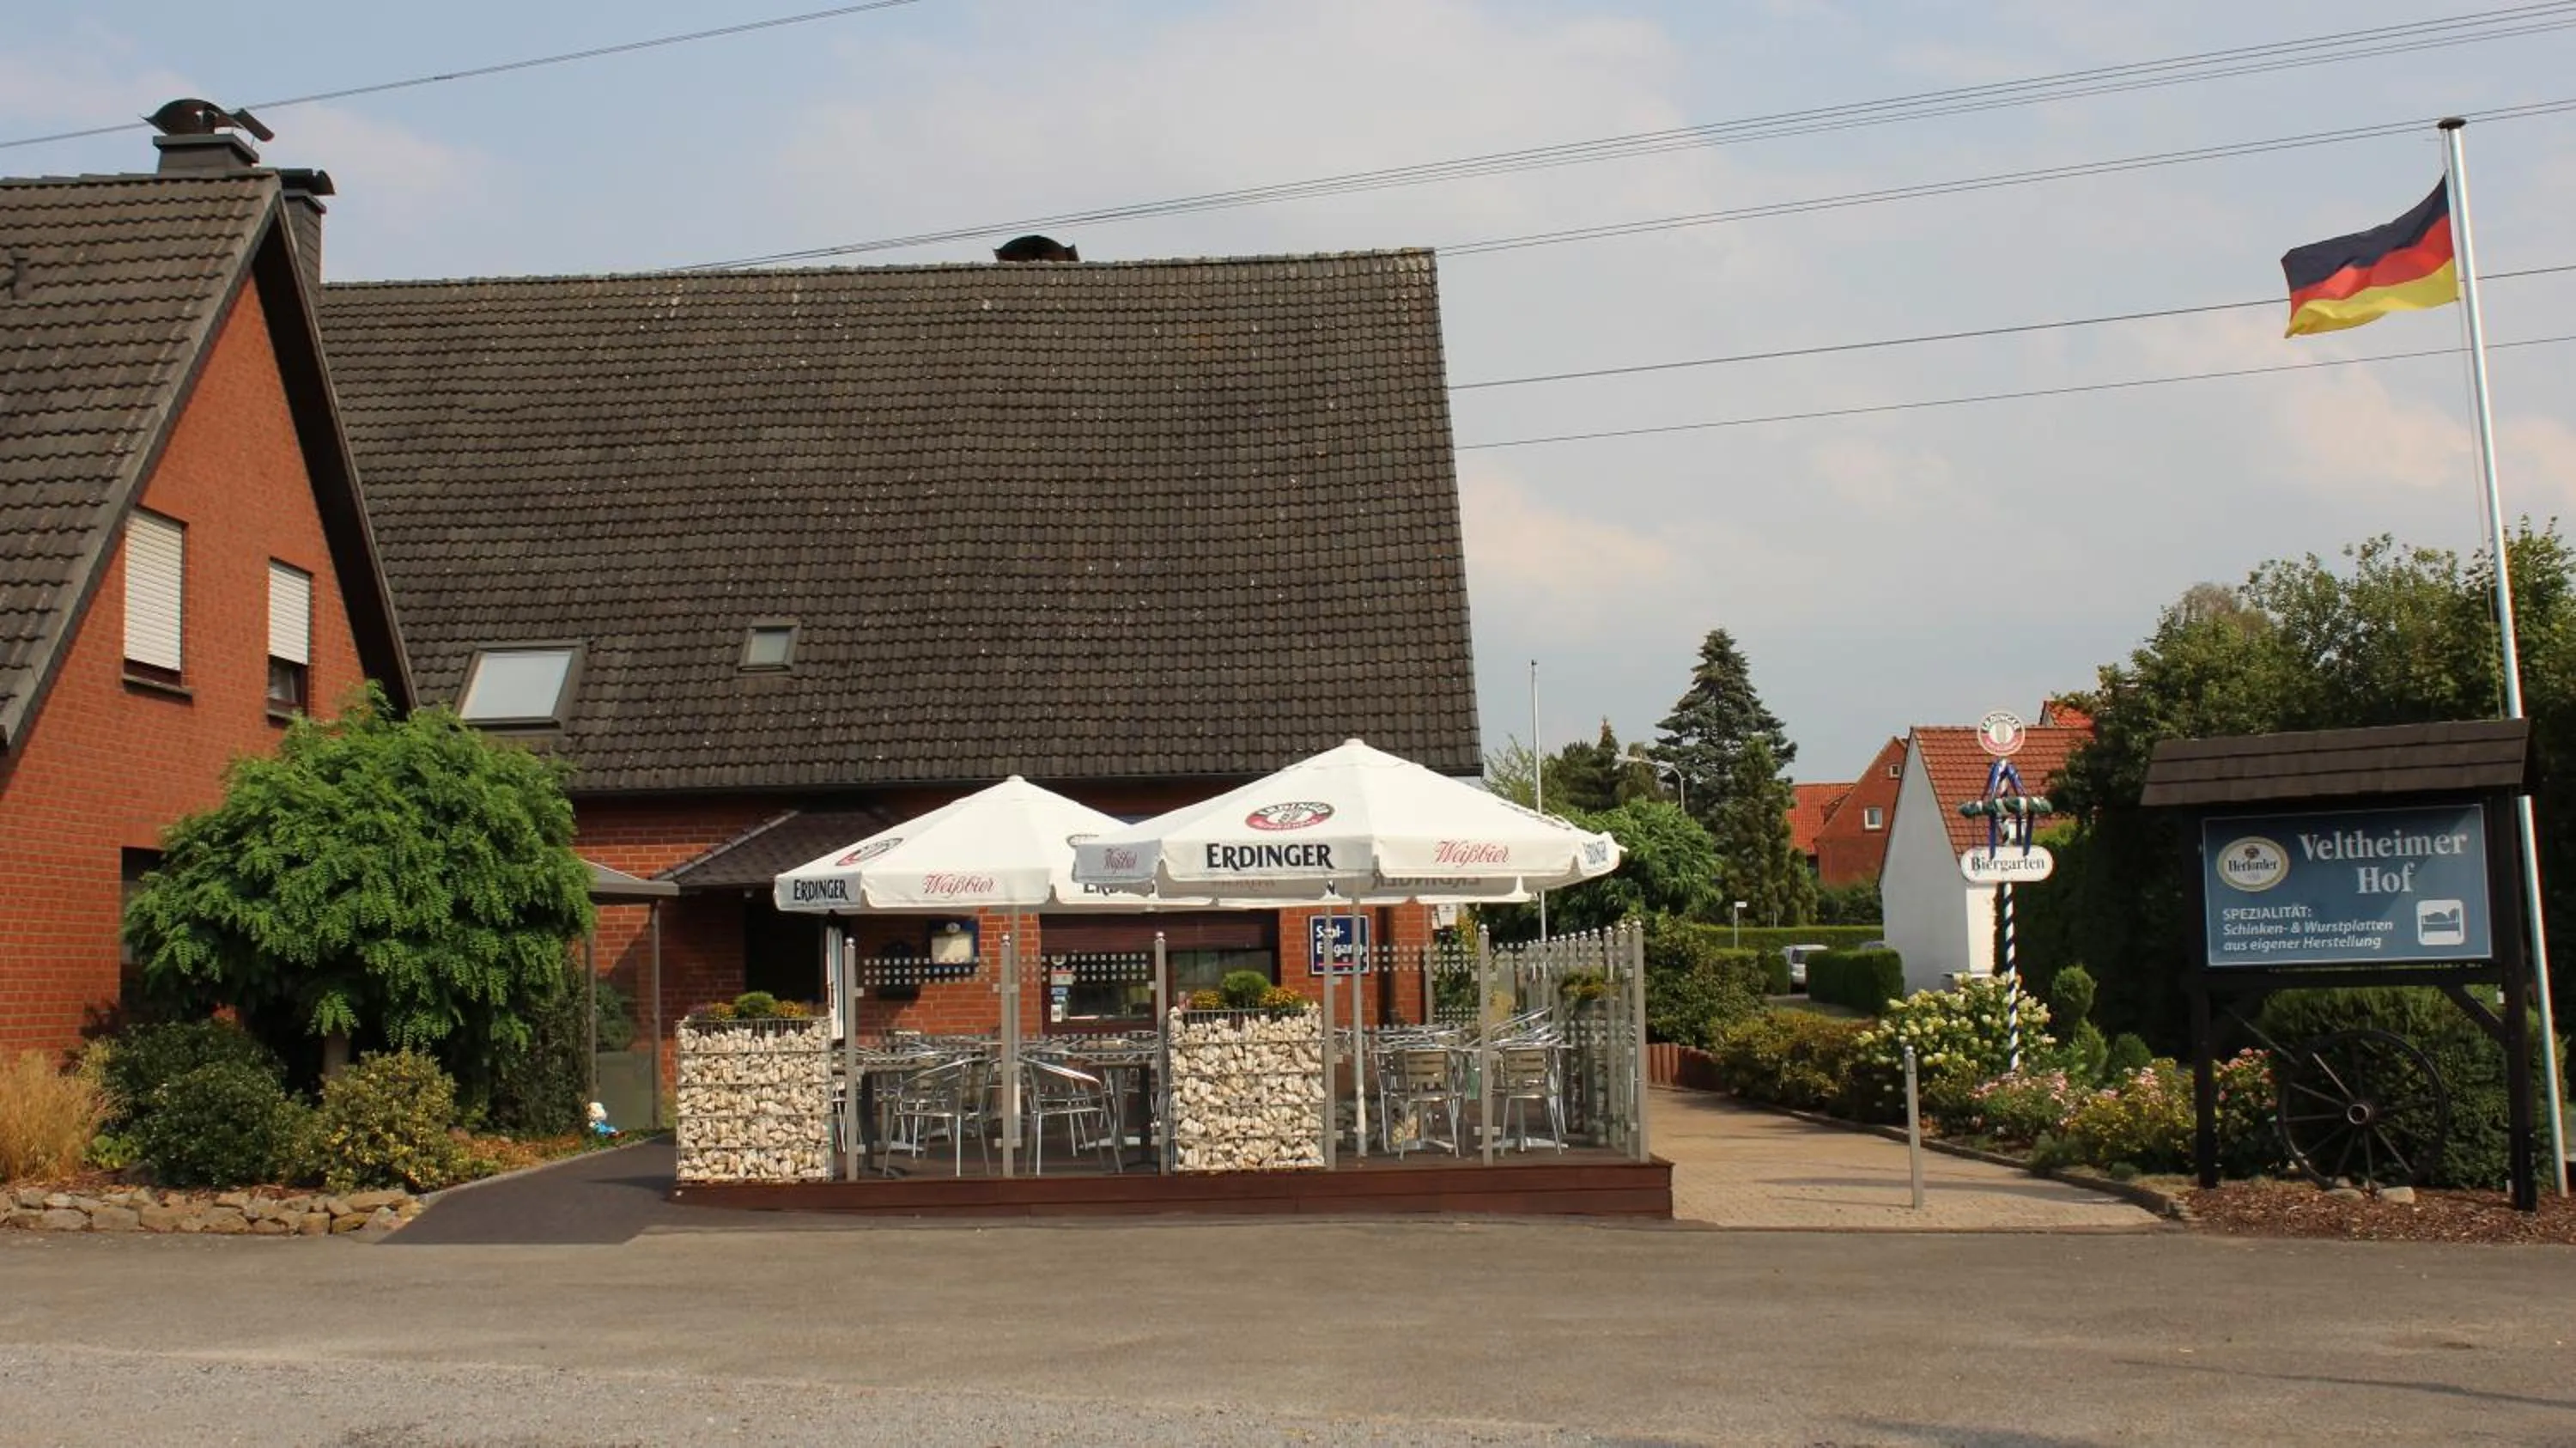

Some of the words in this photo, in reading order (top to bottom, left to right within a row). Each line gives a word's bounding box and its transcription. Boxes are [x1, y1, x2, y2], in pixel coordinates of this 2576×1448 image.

[1206, 842, 1334, 872] ERDINGER
[1435, 840, 1510, 867] Weißbier
[2298, 829, 2469, 861] Veltheimer
[1970, 855, 2045, 873] Biergarten
[793, 879, 849, 902] ERDINGER
[922, 872, 996, 899] Weißbier
[2356, 862, 2415, 895] Hof
[2222, 903, 2312, 922] SPEZIALITÄT:
[2223, 922, 2287, 936] Schinken-
[2290, 921, 2301, 934] &
[2303, 919, 2394, 935] Wurstplatten
[2223, 941, 2247, 952] aus
[2250, 938, 2300, 953] eigener
[2302, 934, 2382, 951] Herstellung
